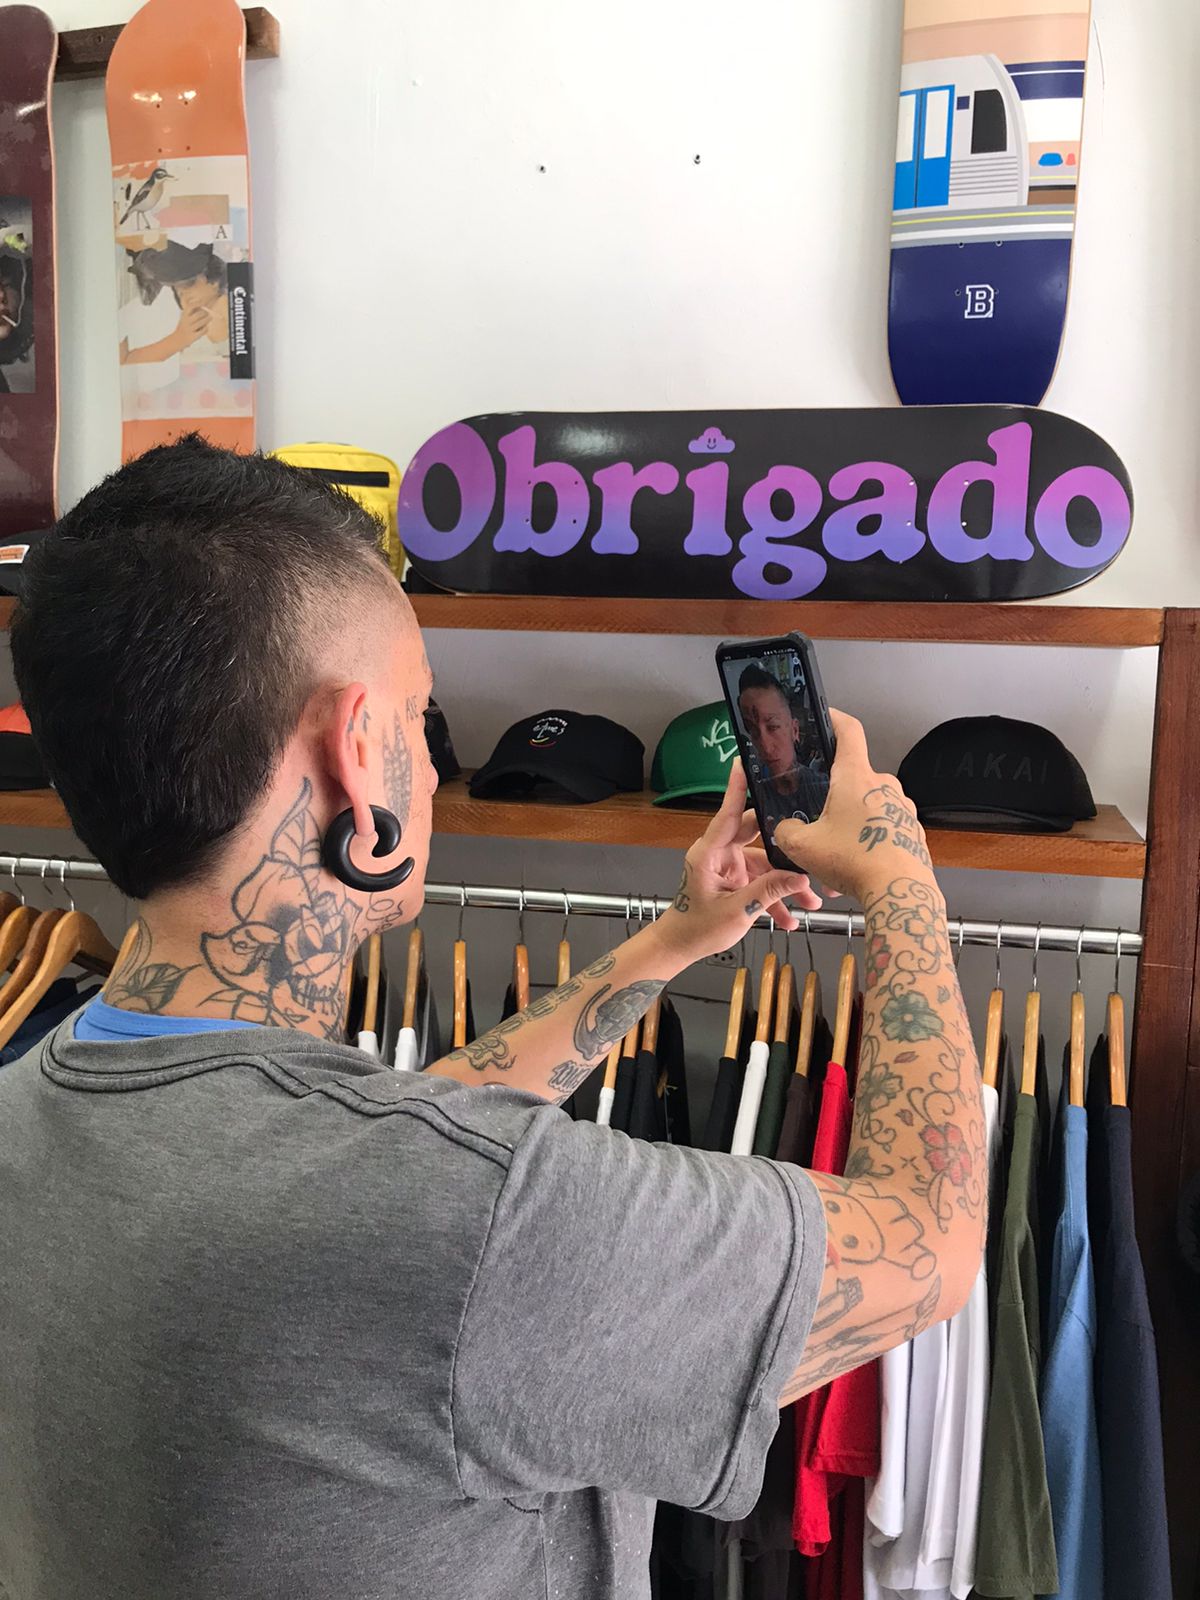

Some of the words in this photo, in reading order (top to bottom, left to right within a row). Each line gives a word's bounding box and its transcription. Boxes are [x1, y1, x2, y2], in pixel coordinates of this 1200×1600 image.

[215, 225, 228, 240] A
[964, 284, 995, 319] B
[233, 286, 248, 355] Continental
[399, 422, 1132, 600] Obrigado
[931, 751, 1049, 785] LAKAI
